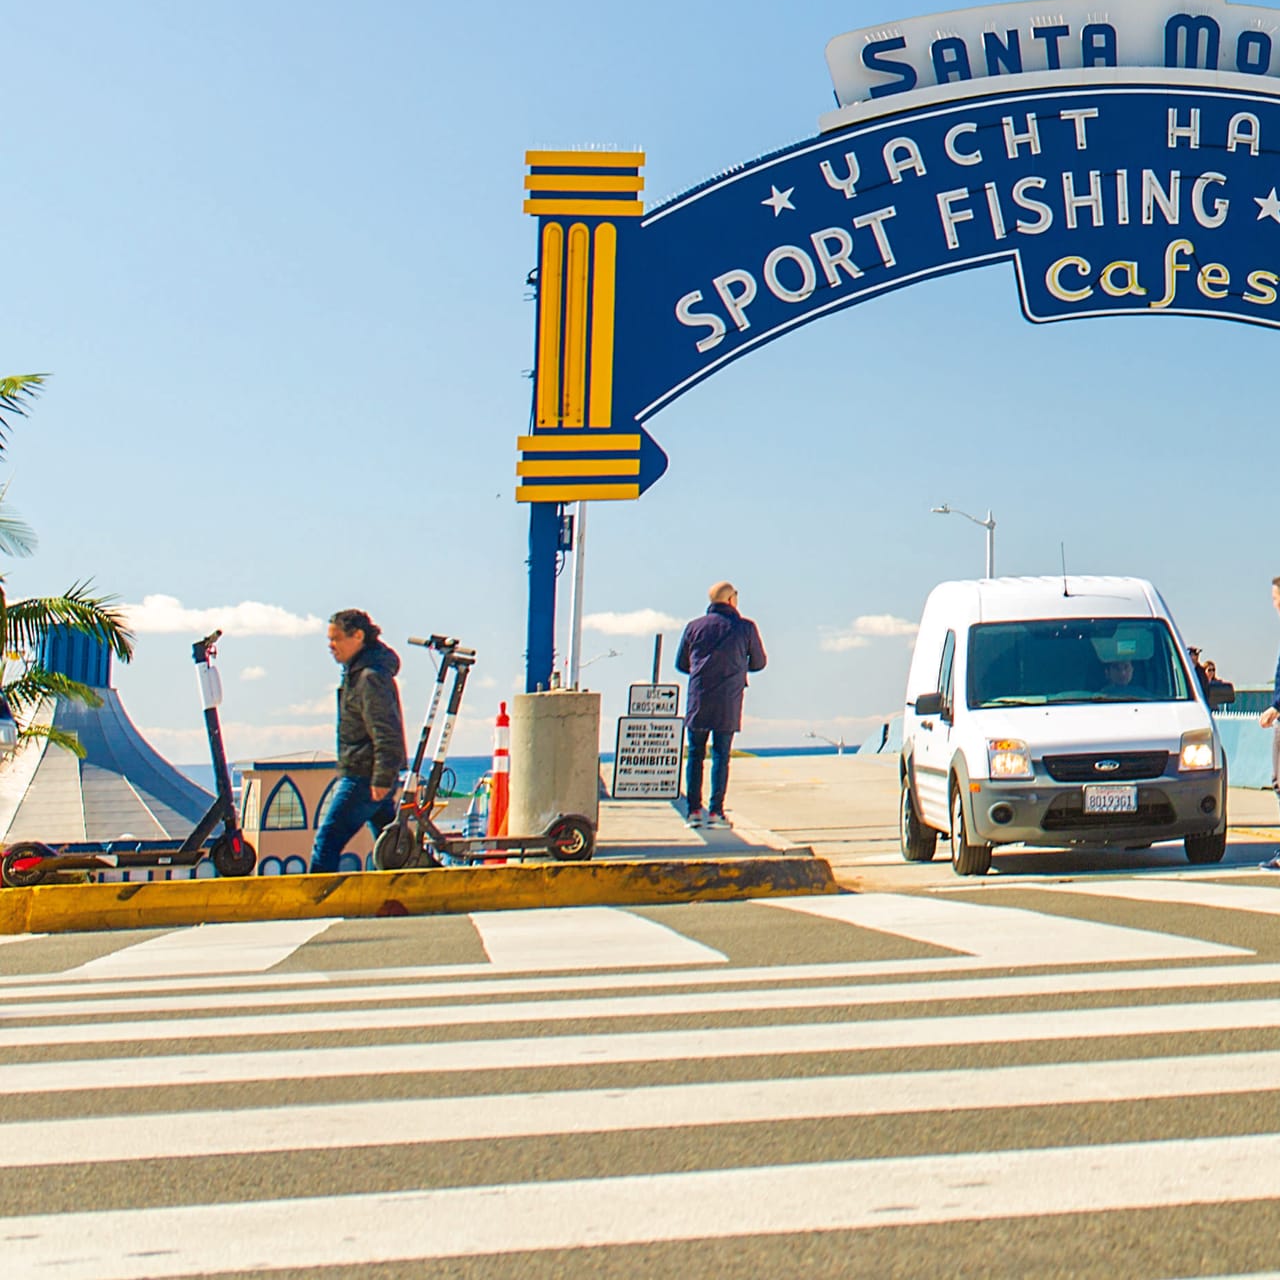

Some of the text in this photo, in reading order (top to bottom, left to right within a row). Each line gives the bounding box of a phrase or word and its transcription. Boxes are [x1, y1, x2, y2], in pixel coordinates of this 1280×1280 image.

[861, 22, 1118, 99] SANTA
[820, 108, 1099, 199] YACHT
[675, 205, 896, 352] SPORT
[936, 169, 1229, 249] FISHING
[1045, 239, 1280, 308] cafes
[632, 702, 675, 712] CROSSWALK
[646, 689, 661, 699] USE
[620, 755, 678, 766] PROHIBITED
